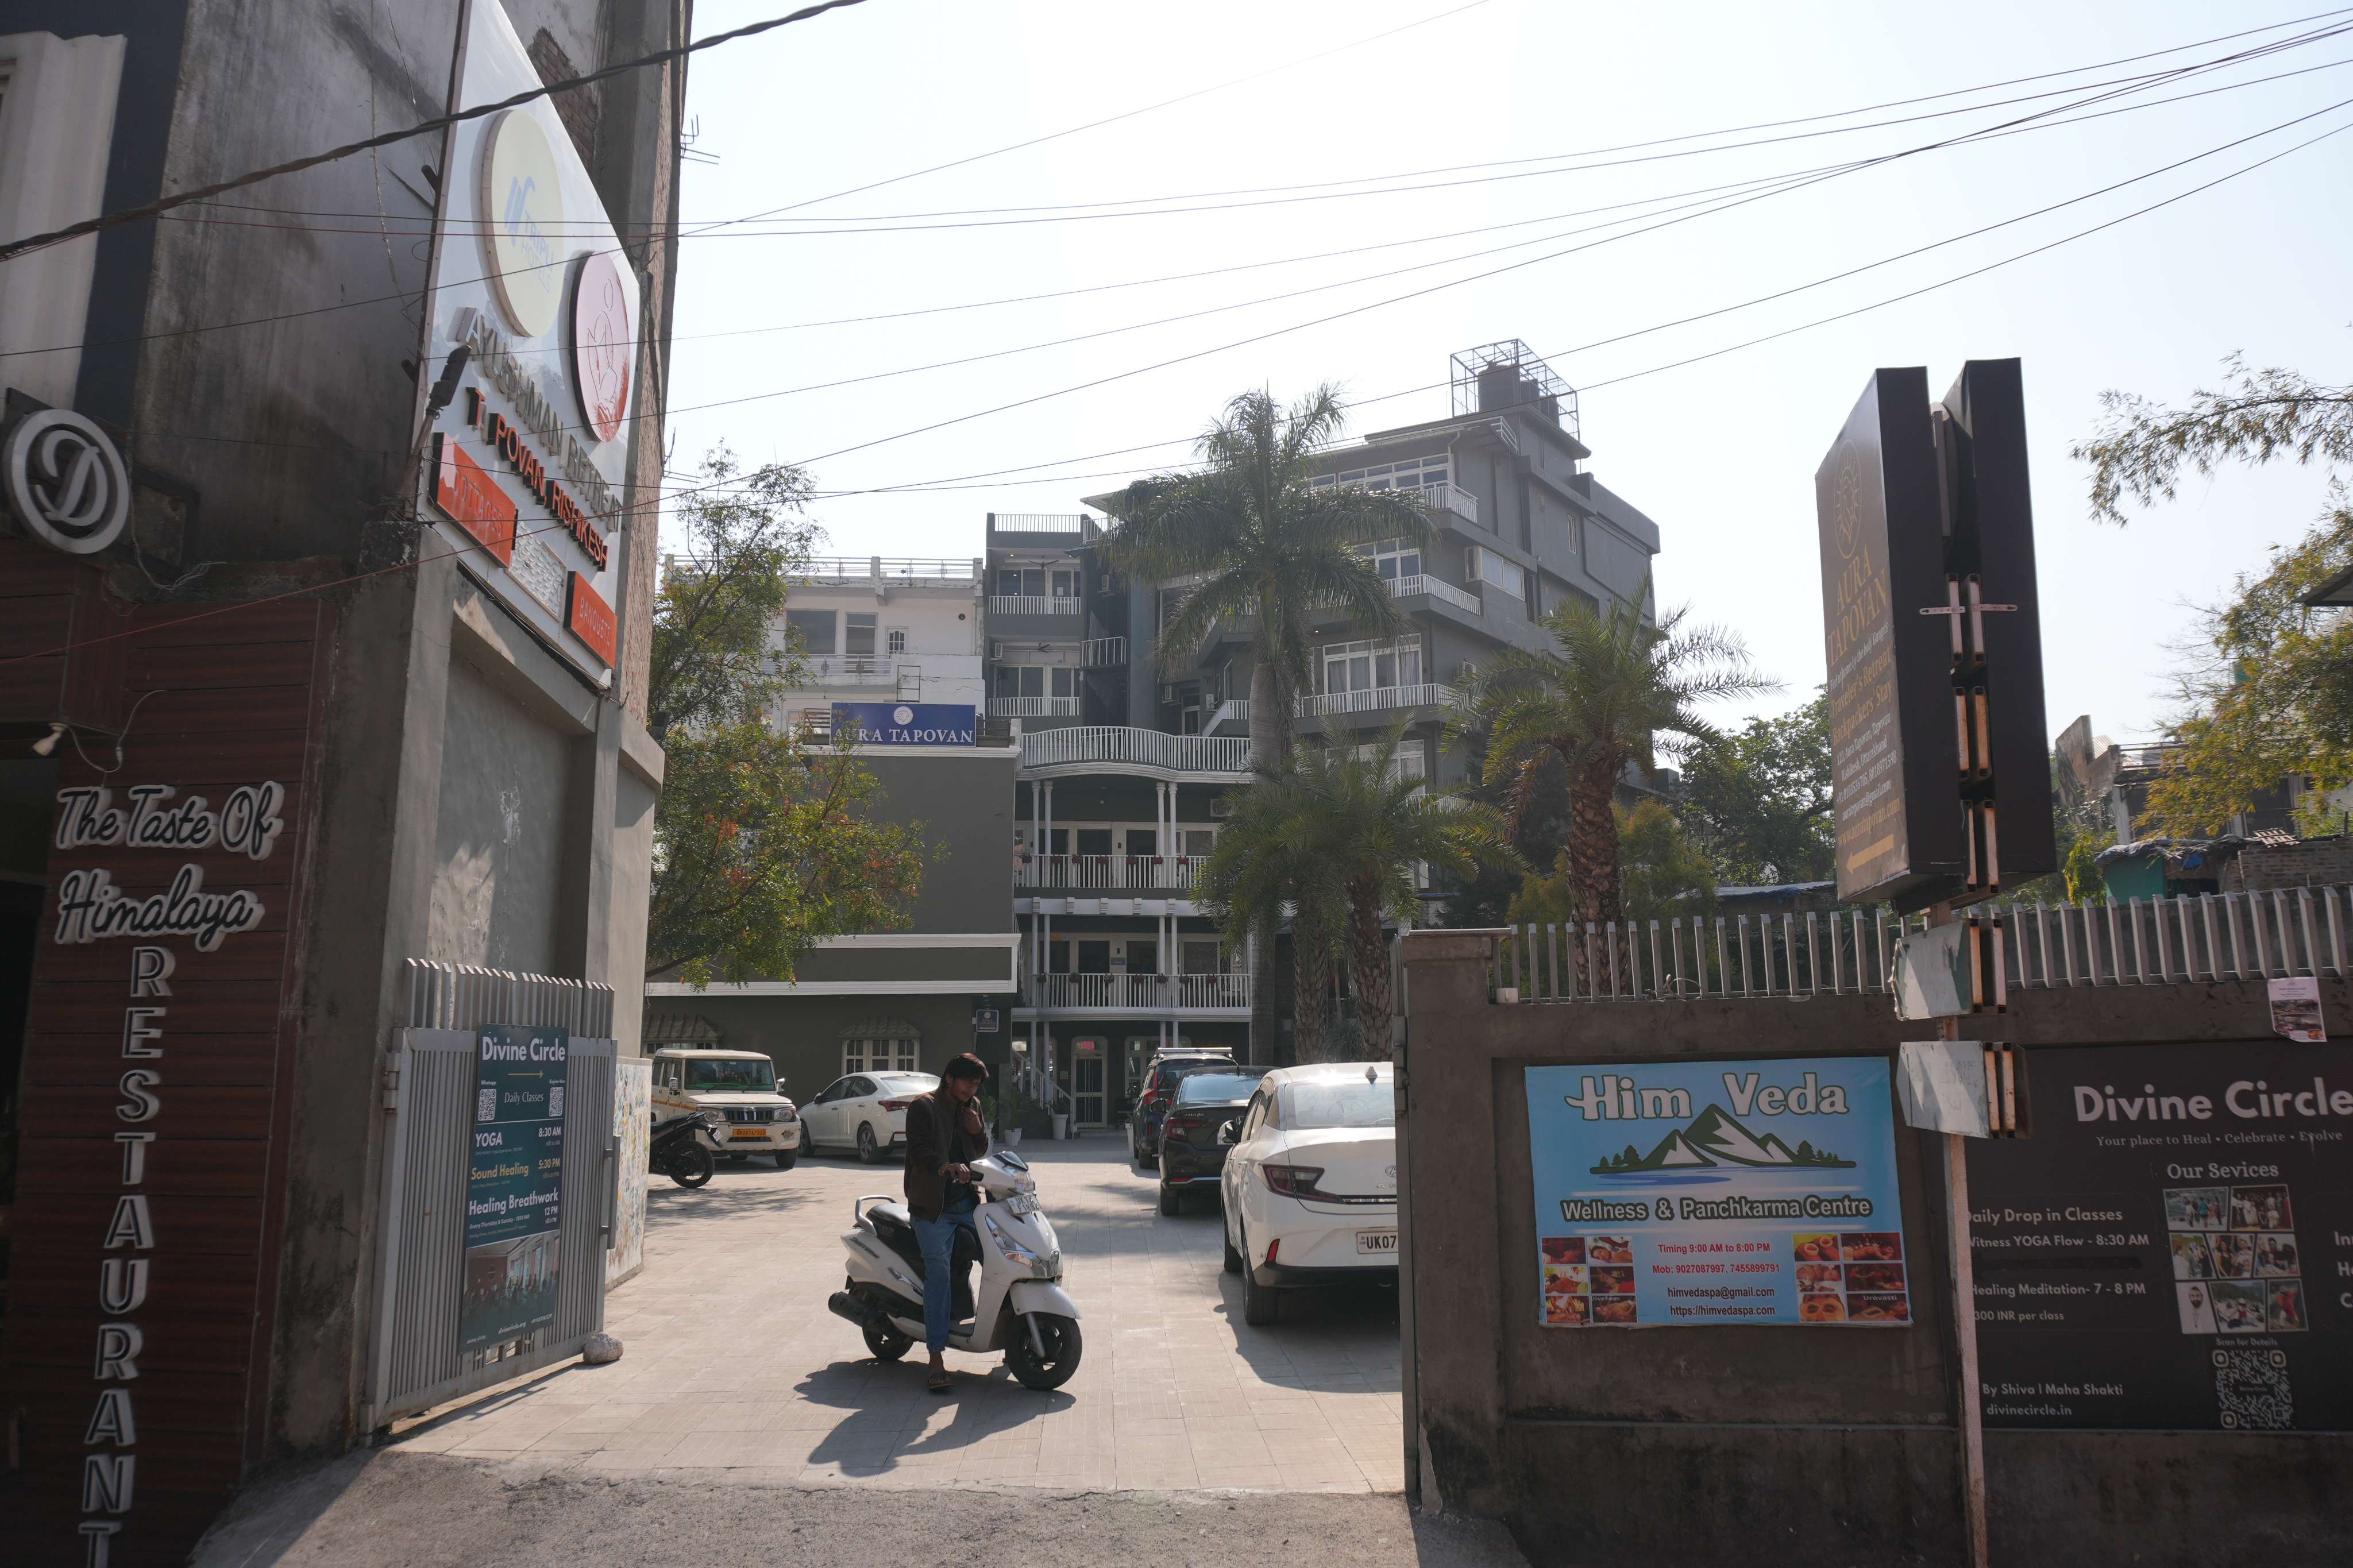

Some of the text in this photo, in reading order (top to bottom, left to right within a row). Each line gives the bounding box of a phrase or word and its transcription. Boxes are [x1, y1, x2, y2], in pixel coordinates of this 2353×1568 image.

[522, 235, 551, 293] HOTELS
[457, 307, 624, 532] AYUSHMAN RETREAT
[466, 386, 609, 571] TPOVAN, RISHIKESH
[1837, 543, 1872, 616] AURA
[1828, 569, 1888, 667] TAPOVAN
[1852, 656, 1857, 670] by
[1864, 638, 1872, 656] holy
[1873, 621, 1889, 646] Ganges
[1831, 643, 1892, 718] Traveler's Retreat
[1876, 678, 1893, 706] Stay
[889, 729, 974, 743] TAPOVAN
[1846, 744, 1854, 759] Aura
[1854, 731, 1873, 751] Tapovan,
[1872, 712, 1891, 737] Tapovan
[1842, 734, 1887, 782] Rishikesh, Uttarakhand
[1843, 779, 1891, 821] auratapovan@gmail.com
[56, 780, 284, 860] The Taste Of
[1838, 798, 1900, 847] www.auratapovan.com
[55, 863, 265, 952] Himalaya
[483, 1036, 565, 1061] Divine Circle
[504, 1091, 543, 1107] Daily Classes
[1564, 1072, 1849, 1121] Him Veda
[2074, 1077, 2353, 1122] Divine Circle
[476, 1131, 503, 1147] YOGA
[539, 1126, 561, 1138] 8:30 AM
[2096, 1129, 2343, 1148] Your place to Heal Celebrate Evolve
[471, 1162, 529, 1180] Sound Healing
[538, 1158, 560, 1170] 5:30 PM
[2167, 1161, 2279, 1179] Our Sevices
[469, 1187, 559, 1215] Healing Breathwork
[1562, 1197, 1871, 1221] Wellness & Panchkarma Centre
[545, 1206, 558, 1216] 12 PM
[2004, 1208, 2042, 1225] Drop
[2047, 1208, 2061, 1222] in
[2065, 1207, 2123, 1222] Classes
[1366, 1235, 1397, 1249] UK07
[1658, 1243, 1770, 1254] Timing 9:00 AM to 8:00 PM
[2013, 1235, 2051, 1247] YOGA
[2054, 1235, 2084, 1246] Flow
[2096, 1234, 2125, 1246] 8:30
[2128, 1234, 2150, 1246] AM
[78, 947, 176, 1568] RESTAURANT
[1653, 1264, 1780, 1275] Mob: 9027087997, 7455899791
[1668, 1287, 1775, 1299] himvedaspa@gmail.com
[2019, 1283, 2090, 1295] Meditation-
[2093, 1283, 2103, 1294] 7
[2114, 1283, 2123, 1294] 8
[2126, 1282, 2146, 1295] PM
[1671, 1306, 1776, 1317] https://himvedaspa.com
[1974, 1310, 2064, 1323] 300 INR per class
[2216, 1338, 2235, 1346] Scan
[2250, 1338, 2278, 1346] Details
[1982, 1384, 1997, 1397] By
[2001, 1383, 2035, 1395] Shiva
[2046, 1383, 2080, 1395] Maha
[2084, 1382, 2124, 1395] Shakti
[1986, 1404, 2072, 1415] divinecircle.in
